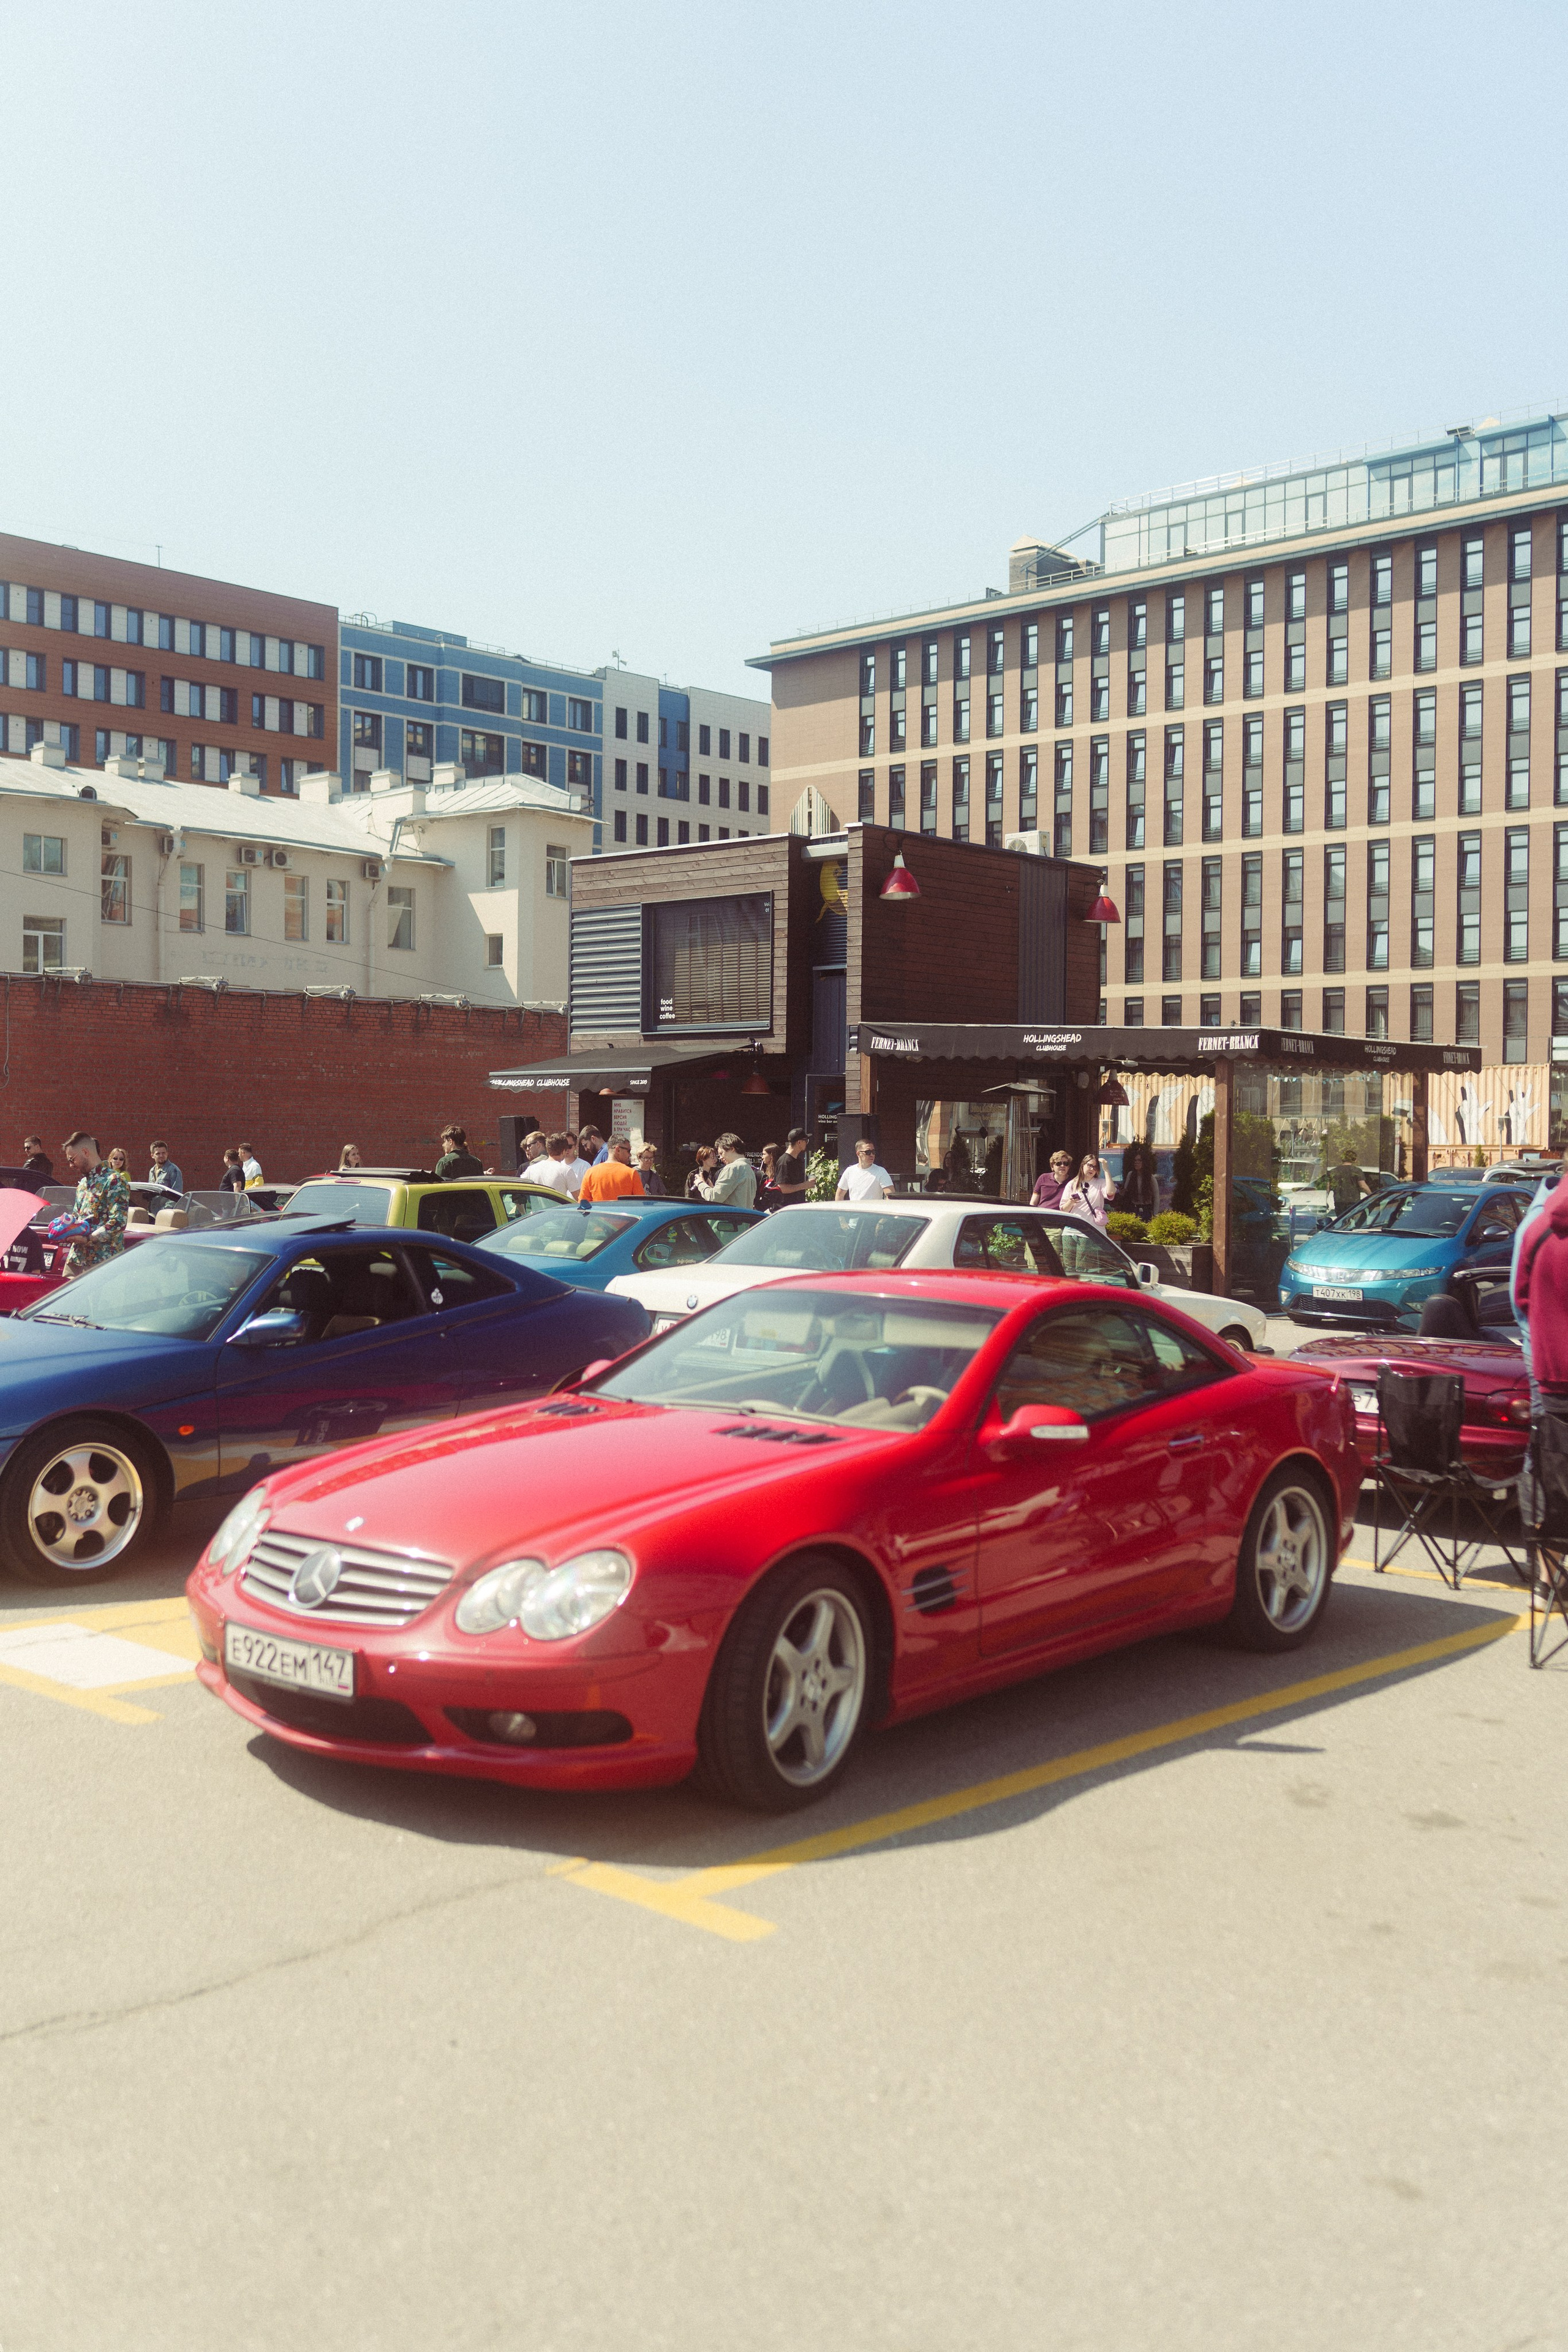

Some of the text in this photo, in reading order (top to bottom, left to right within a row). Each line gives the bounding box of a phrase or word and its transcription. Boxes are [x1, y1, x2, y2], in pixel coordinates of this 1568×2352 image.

[870, 1036, 919, 1051] FERNET-BRANCA
[1023, 1033, 1082, 1043] HOLLINGSHEAD
[1198, 1035, 1259, 1050] FERNET-BRANCA
[1364, 1045, 1396, 1055] HOLLINGSHEAD
[489, 1079, 534, 1087] HOLLINGSHEAD
[313, 1653, 345, 1679] 147
